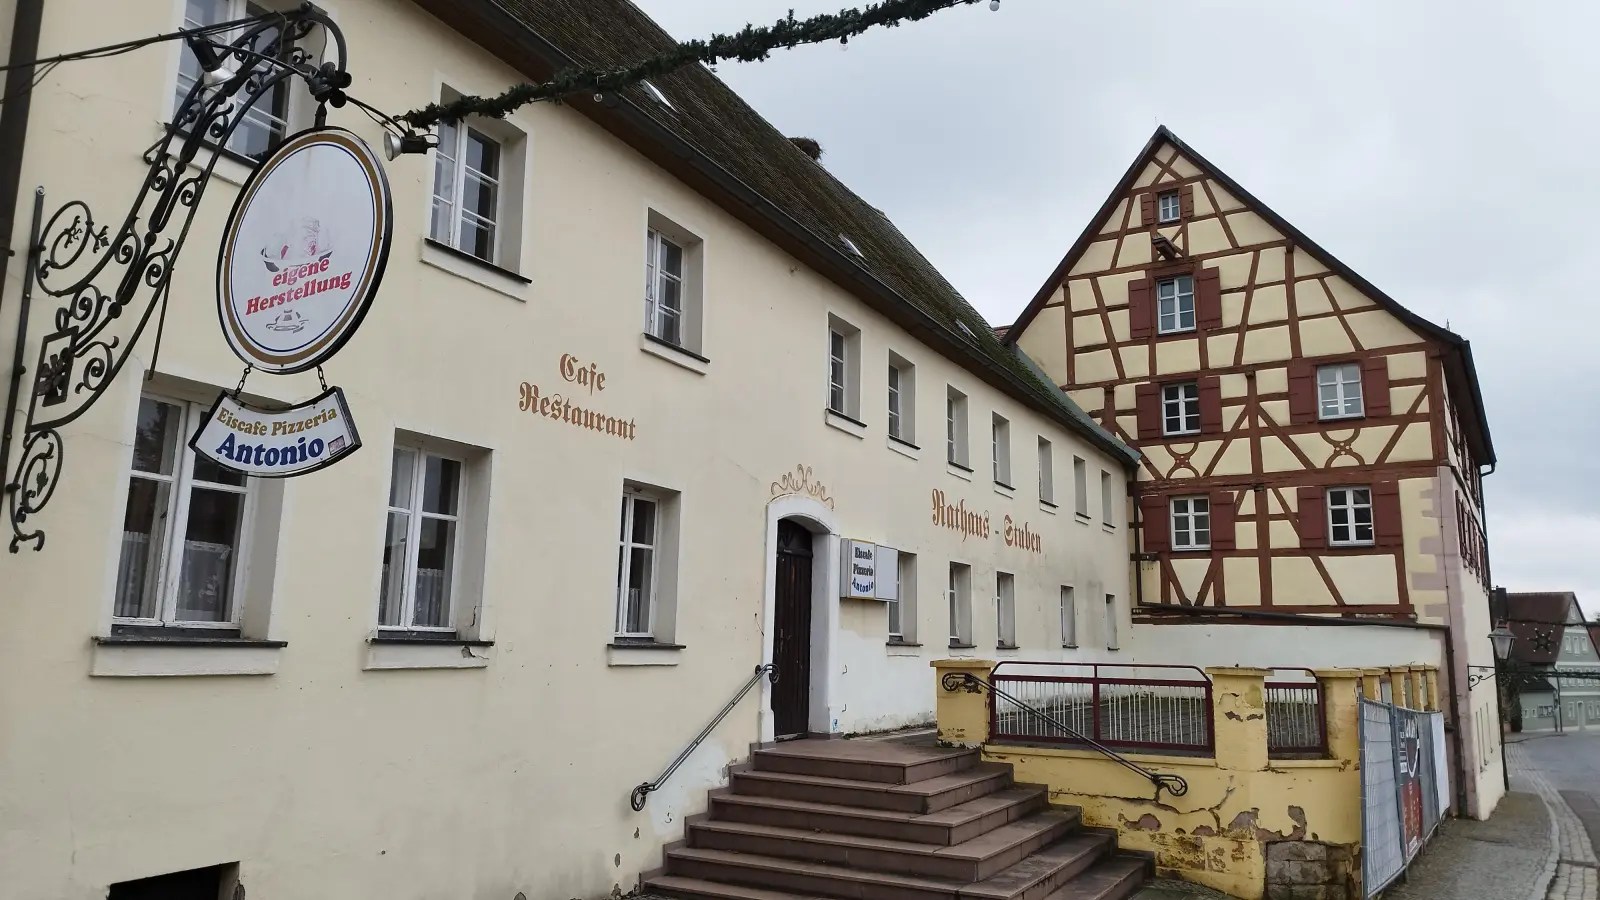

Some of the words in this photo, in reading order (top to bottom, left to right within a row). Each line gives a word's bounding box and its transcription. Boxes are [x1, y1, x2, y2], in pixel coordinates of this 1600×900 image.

[272, 258, 330, 287] eigene
[245, 271, 353, 316] Herstellung
[559, 353, 606, 396] Cafe
[216, 406, 268, 436] Eiscafe
[271, 407, 337, 436] Pizzeria
[518, 381, 636, 441] Restaurant
[215, 432, 325, 467] Antonio
[932, 488, 990, 543] Rathaus
[1004, 514, 1042, 554] Stuben
[852, 562, 874, 577] Pizzeria
[852, 576, 874, 593] Antonio
